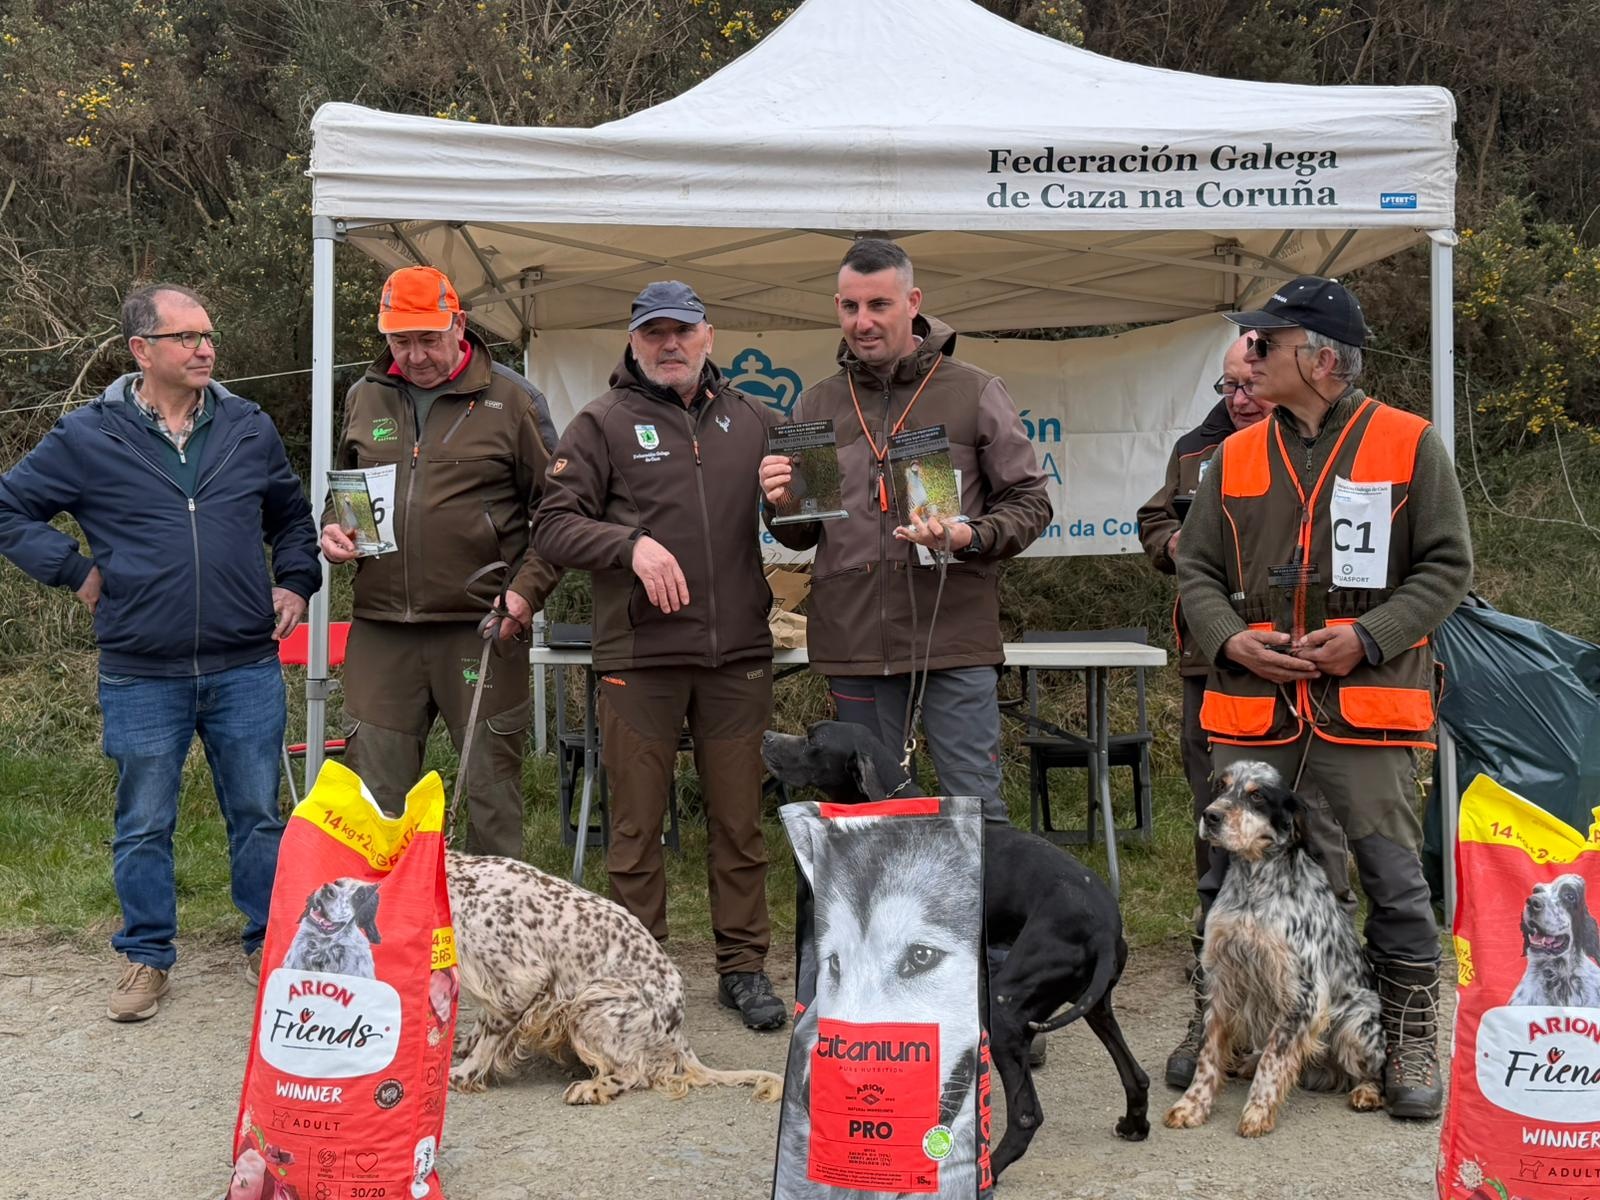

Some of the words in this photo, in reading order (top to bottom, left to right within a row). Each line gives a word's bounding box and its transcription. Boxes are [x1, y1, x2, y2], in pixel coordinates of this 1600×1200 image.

[987, 145, 1199, 174] Federación
[1209, 143, 1339, 176] Galega
[987, 183, 1031, 209] de
[1040, 183, 1126, 209] Caza
[1138, 184, 1187, 209] na
[1195, 179, 1338, 209] Coruña
[1069, 519, 1095, 537] da
[1333, 518, 1376, 554] C1
[323, 809, 343, 830] 14
[1490, 822, 1513, 839] 14
[288, 980, 356, 1008] ARION
[270, 1008, 384, 1049] Friends
[1528, 1016, 1600, 1044] ARION
[816, 1033, 931, 1062] titanium
[276, 1080, 344, 1104] WINNER
[856, 1084, 885, 1095] ARION
[293, 1118, 342, 1132] ADULT
[849, 1120, 893, 1140] PRO
[1521, 1126, 1600, 1149] WINNER
[1548, 1167, 1600, 1178] ADULT
[350, 1187, 386, 1198] 30/20
